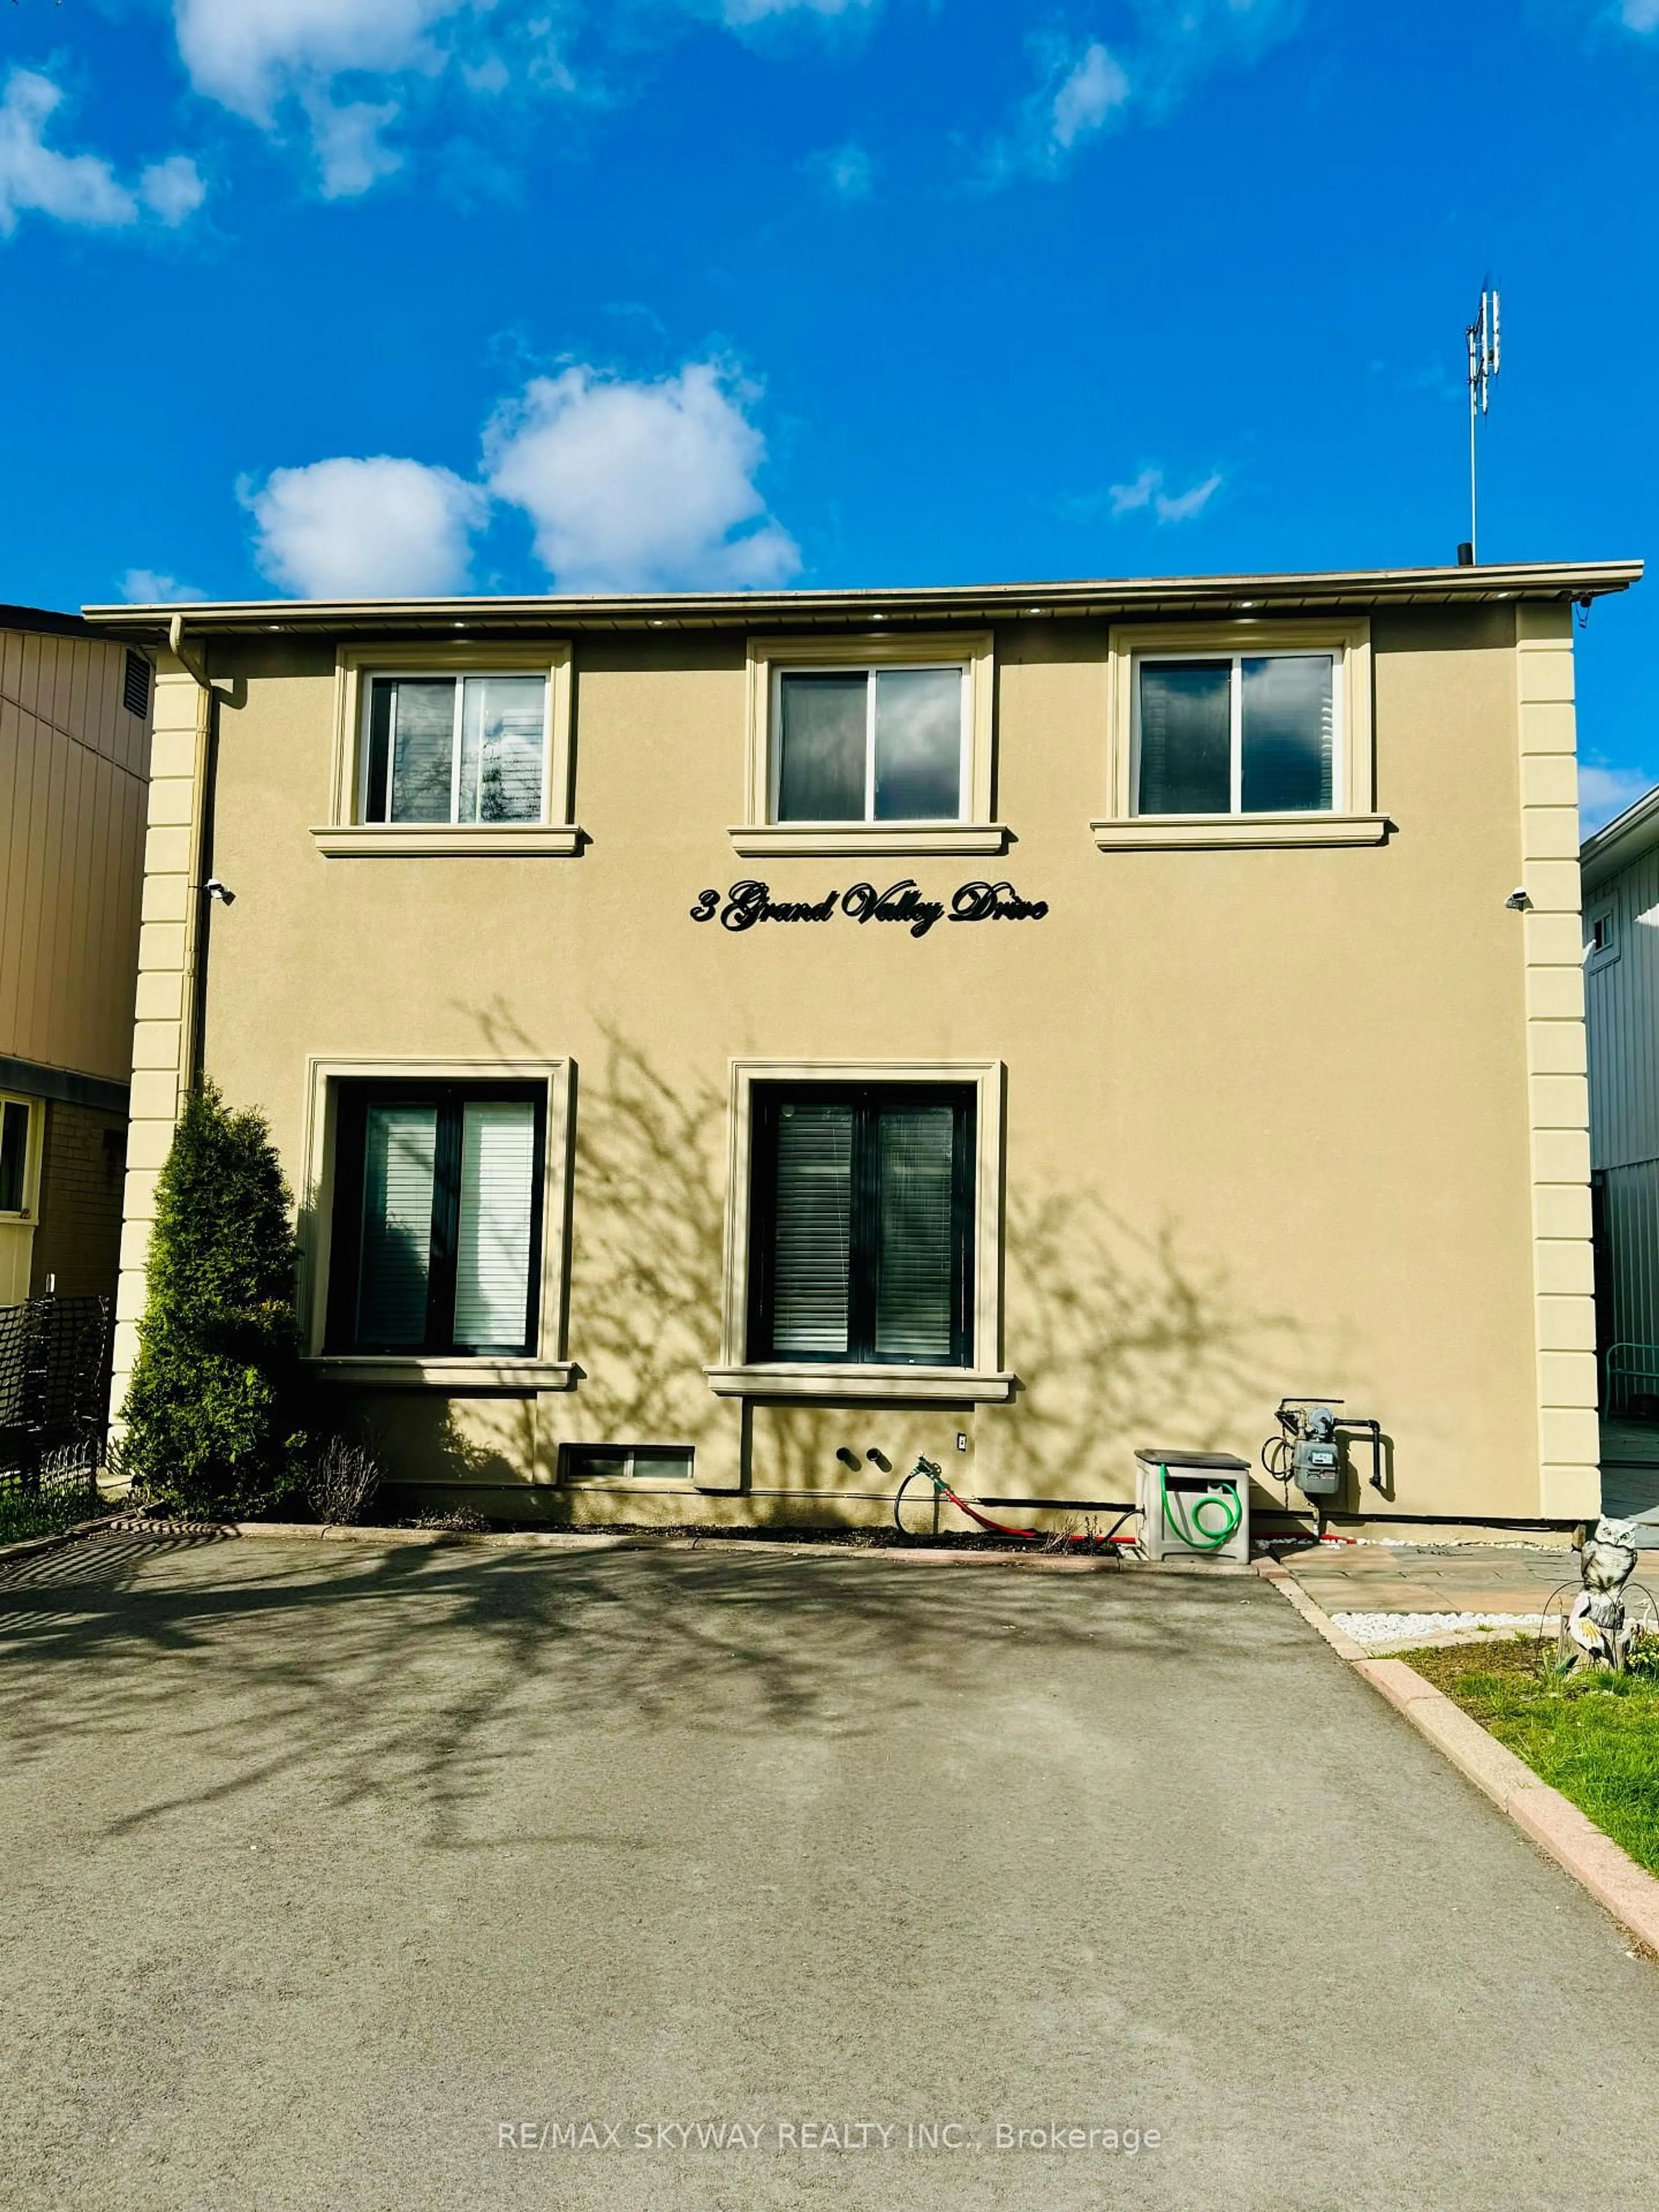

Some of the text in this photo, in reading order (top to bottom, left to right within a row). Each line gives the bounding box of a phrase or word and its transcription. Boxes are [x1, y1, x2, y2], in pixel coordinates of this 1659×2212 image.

[690, 879, 1049, 938] 3 Grand Valley Drive
